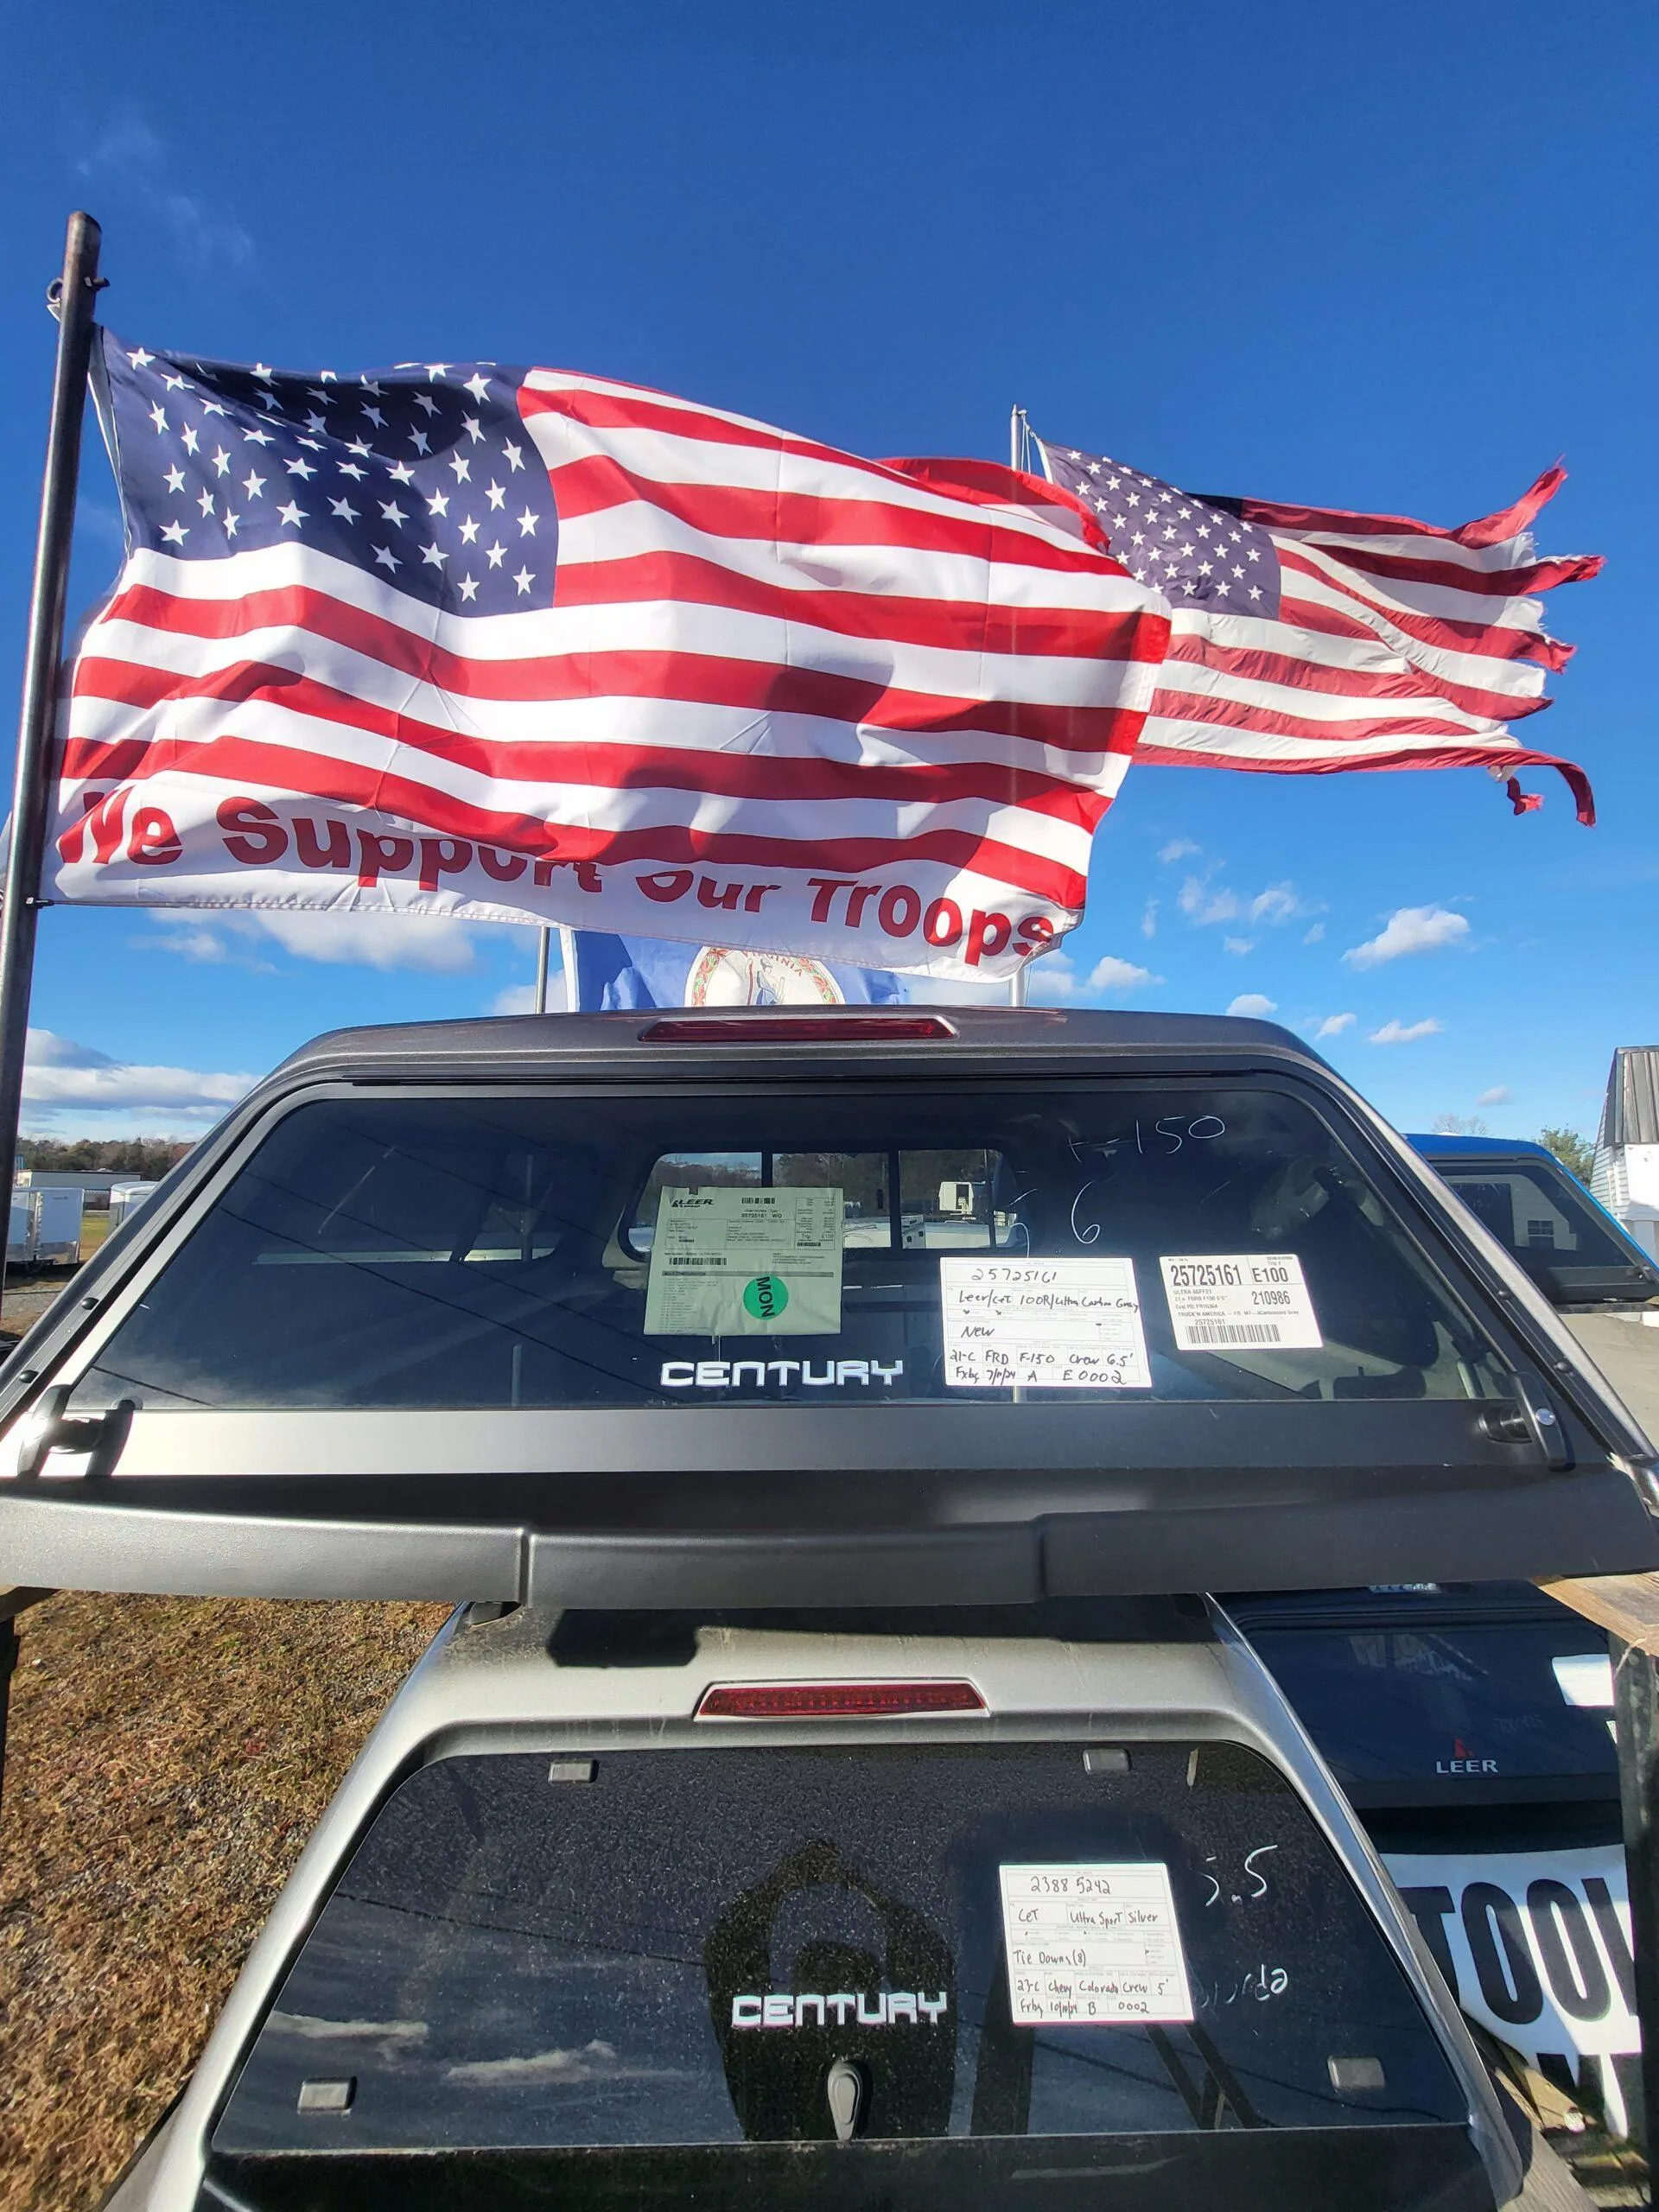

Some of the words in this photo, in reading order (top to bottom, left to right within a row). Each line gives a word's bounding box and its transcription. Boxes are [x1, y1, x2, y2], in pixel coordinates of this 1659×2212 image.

[55, 785, 183, 865] We
[216, 796, 602, 893] Support
[807, 877, 1055, 967] Troops
[972, 1268, 1057, 1283] 25725161
[1171, 1264, 1243, 1286] 25725161
[1252, 1267, 1288, 1282] E100
[1252, 1291, 1291, 1305] 210986
[1020, 1352, 1055, 1364] F-150
[660, 1359, 904, 1387] CENTURY
[1027, 1370, 1038, 1382] A
[1435, 1759, 1500, 1774] LEER
[1128, 1910, 1159, 1924] Silver
[1013, 1949, 1032, 1964] Tie
[1078, 1980, 1119, 1994] Colorado
[1122, 1981, 1147, 1993] Crew
[731, 1991, 948, 2028] CENTURY
[1087, 2001, 1096, 2015] B
[1118, 2001, 1150, 2013] 0002
